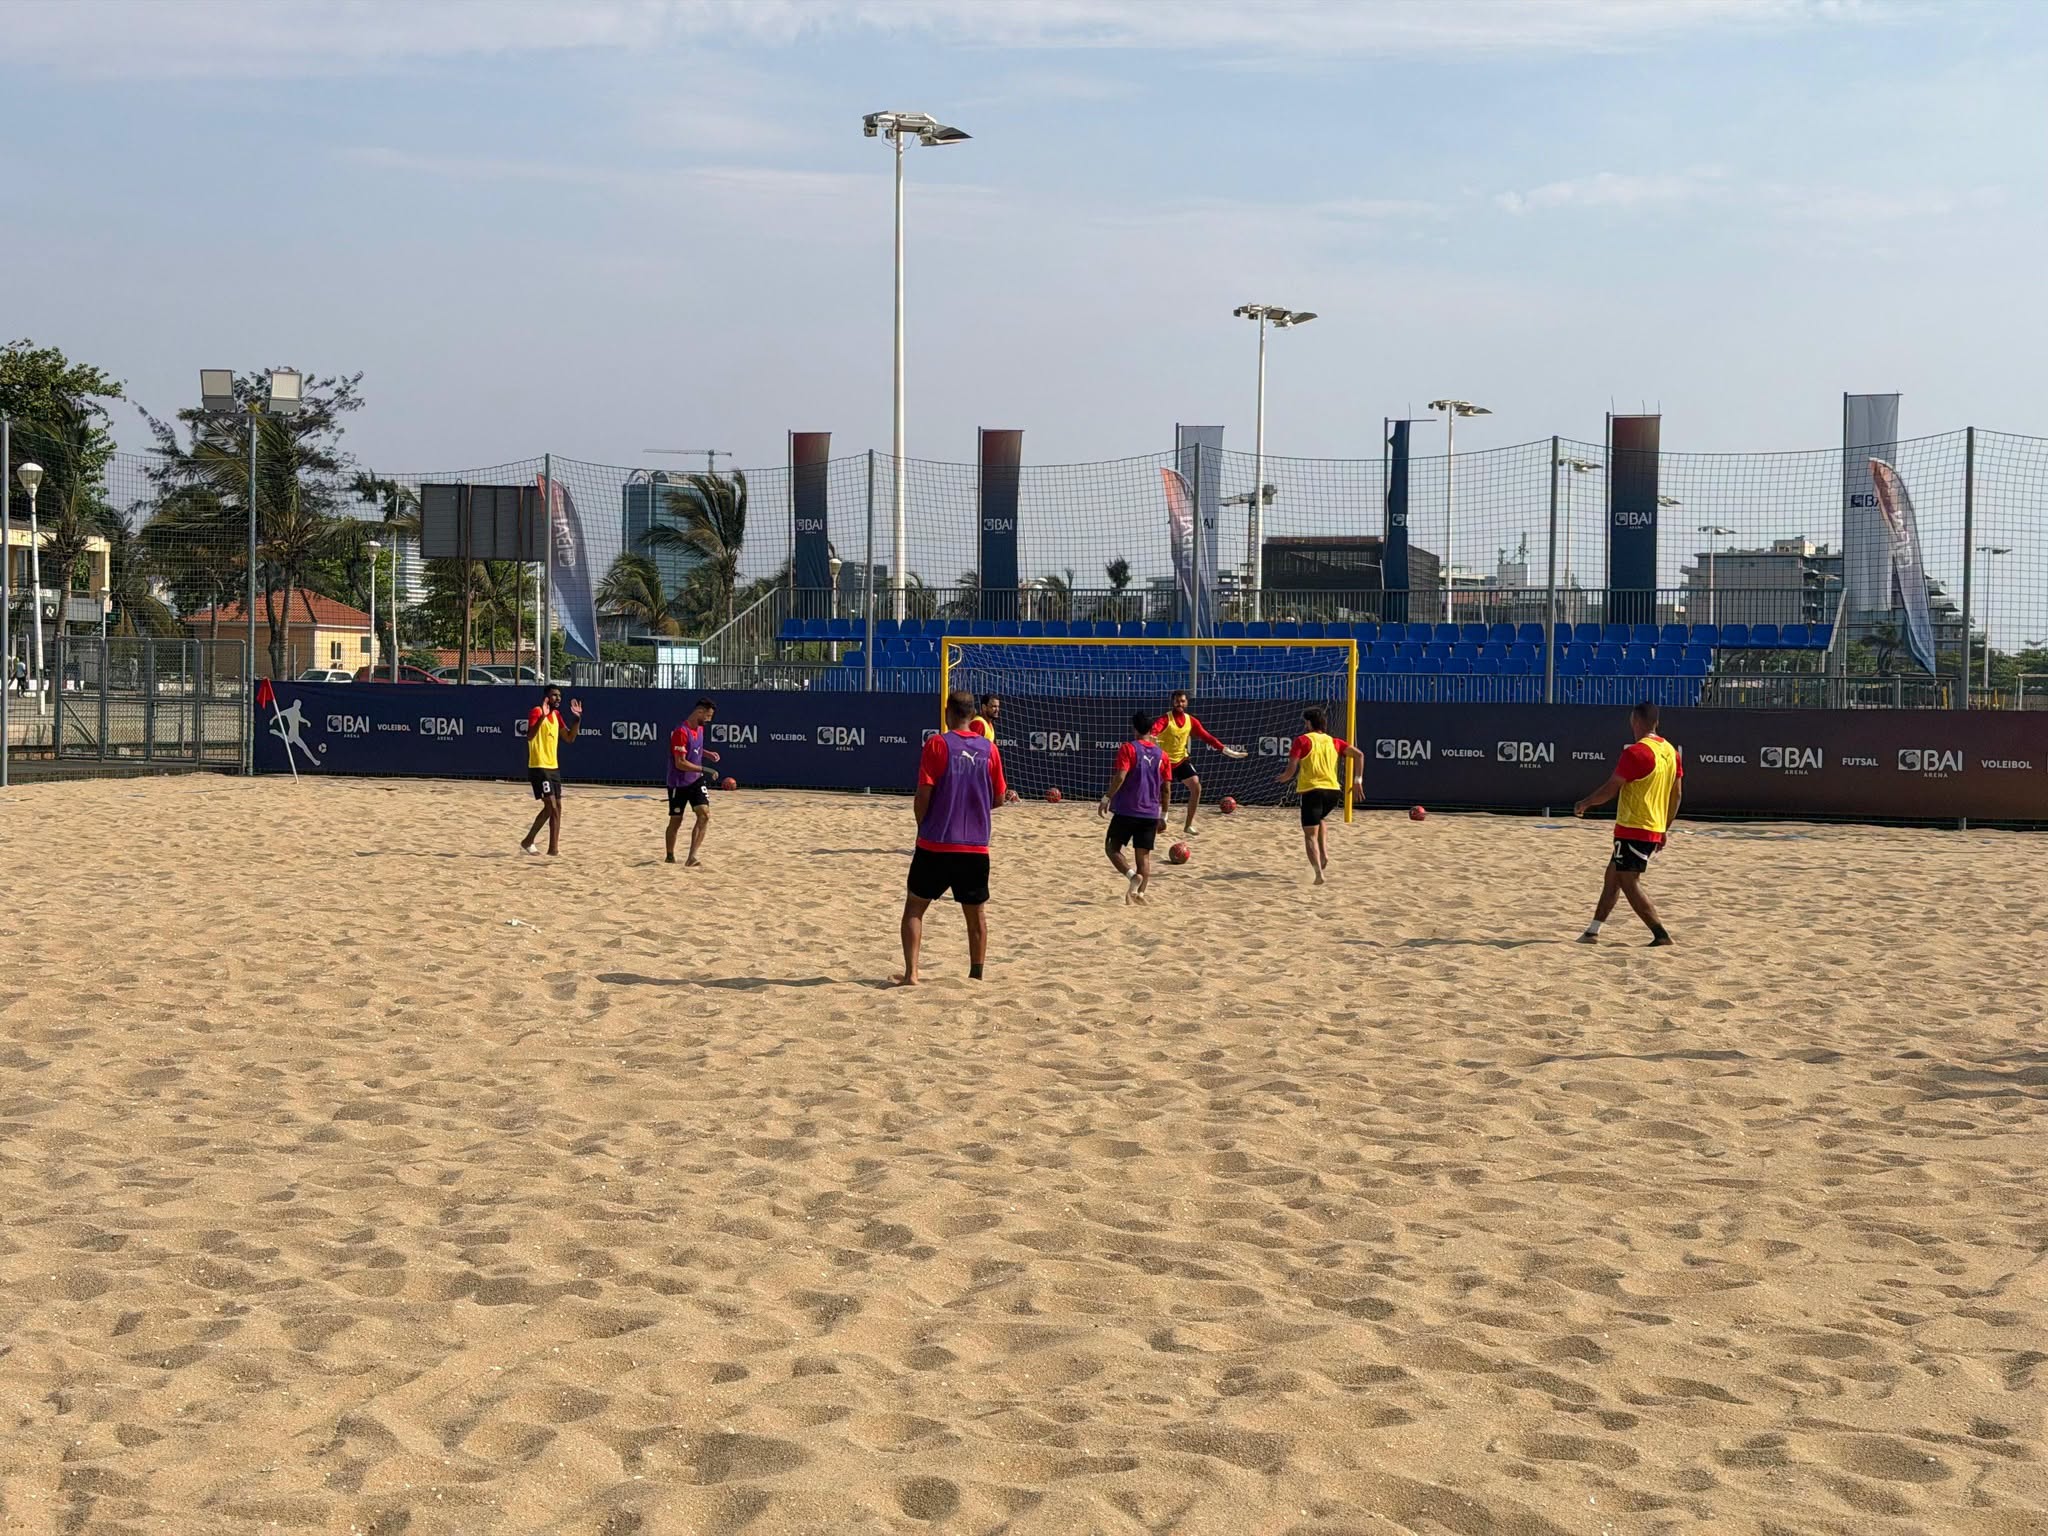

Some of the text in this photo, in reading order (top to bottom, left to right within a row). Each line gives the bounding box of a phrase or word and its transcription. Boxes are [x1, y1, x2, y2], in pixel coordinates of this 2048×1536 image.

[805, 518, 823, 530] BAI
[994, 518, 1013, 530] BAI
[1629, 512, 1652, 525] BAI
[343, 715, 370, 733] BAI
[377, 723, 411, 732] VOLEIBOL
[436, 717, 464, 736] BAI
[476, 725, 502, 734] FUTSAL
[577, 728, 602, 736] LEIBOL
[629, 722, 657, 741] BAI
[728, 724, 758, 743] BAI
[770, 733, 807, 742] VOLEIBOL
[835, 727, 865, 746] BAI
[879, 735, 908, 744] FUTSAL
[996, 738, 1018, 747] EIBOL
[1049, 731, 1080, 751] BAI
[1397, 739, 1431, 760] BAI
[1441, 749, 1485, 758] VOLEIBOL
[1519, 741, 1555, 763] BAI
[1572, 751, 1606, 761] FUTSAL
[1699, 754, 1747, 764] VOLEIBOL
[1784, 747, 1823, 769] BAI
[1842, 757, 1879, 767] FUTSAL
[1923, 749, 1963, 772] BAI
[1981, 759, 2033, 769] VOLEIBOL
